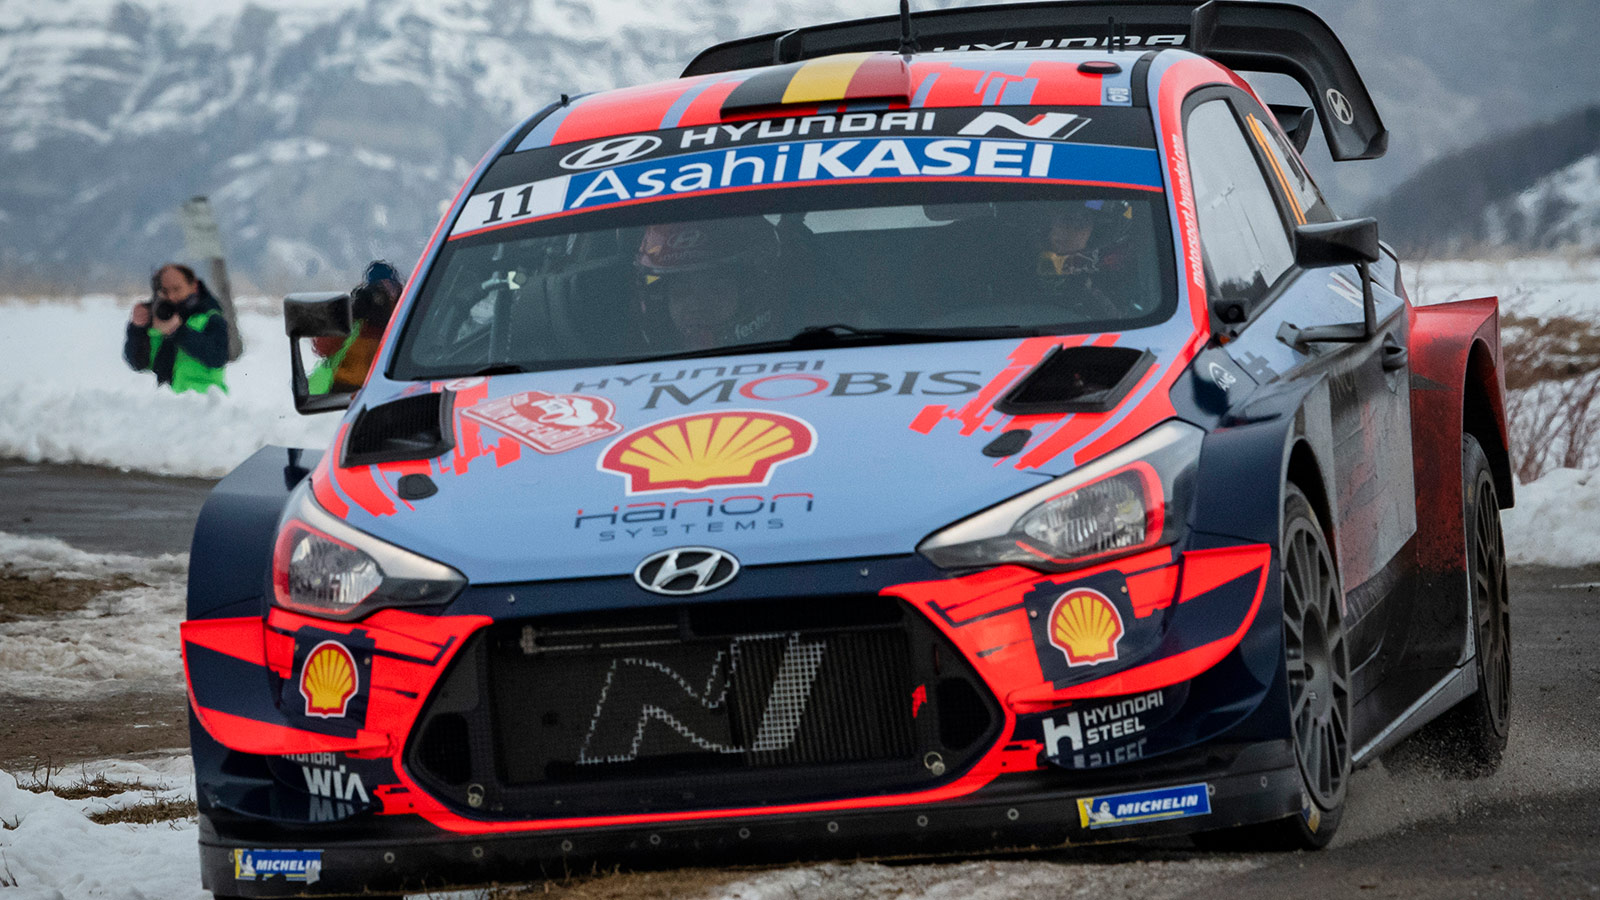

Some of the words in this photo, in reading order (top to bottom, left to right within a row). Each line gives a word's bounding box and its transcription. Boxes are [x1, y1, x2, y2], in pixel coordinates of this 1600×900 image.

[679, 111, 936, 149] HYUNDAI
[482, 185, 535, 226] 11
[1171, 133, 1204, 289] motorsport.hyundai.com
[571, 359, 826, 394] HYUNDAI
[641, 370, 983, 411] MOBIS
[599, 518, 785, 543] SYSTEMS
[1083, 690, 1164, 727] HYUNDAI
[1086, 717, 1146, 745] STEEL
[281, 752, 337, 767] UNDAI
[302, 764, 370, 804] WIA
[1116, 794, 1199, 816] MICHELIN
[255, 859, 322, 872] MICHELIN
